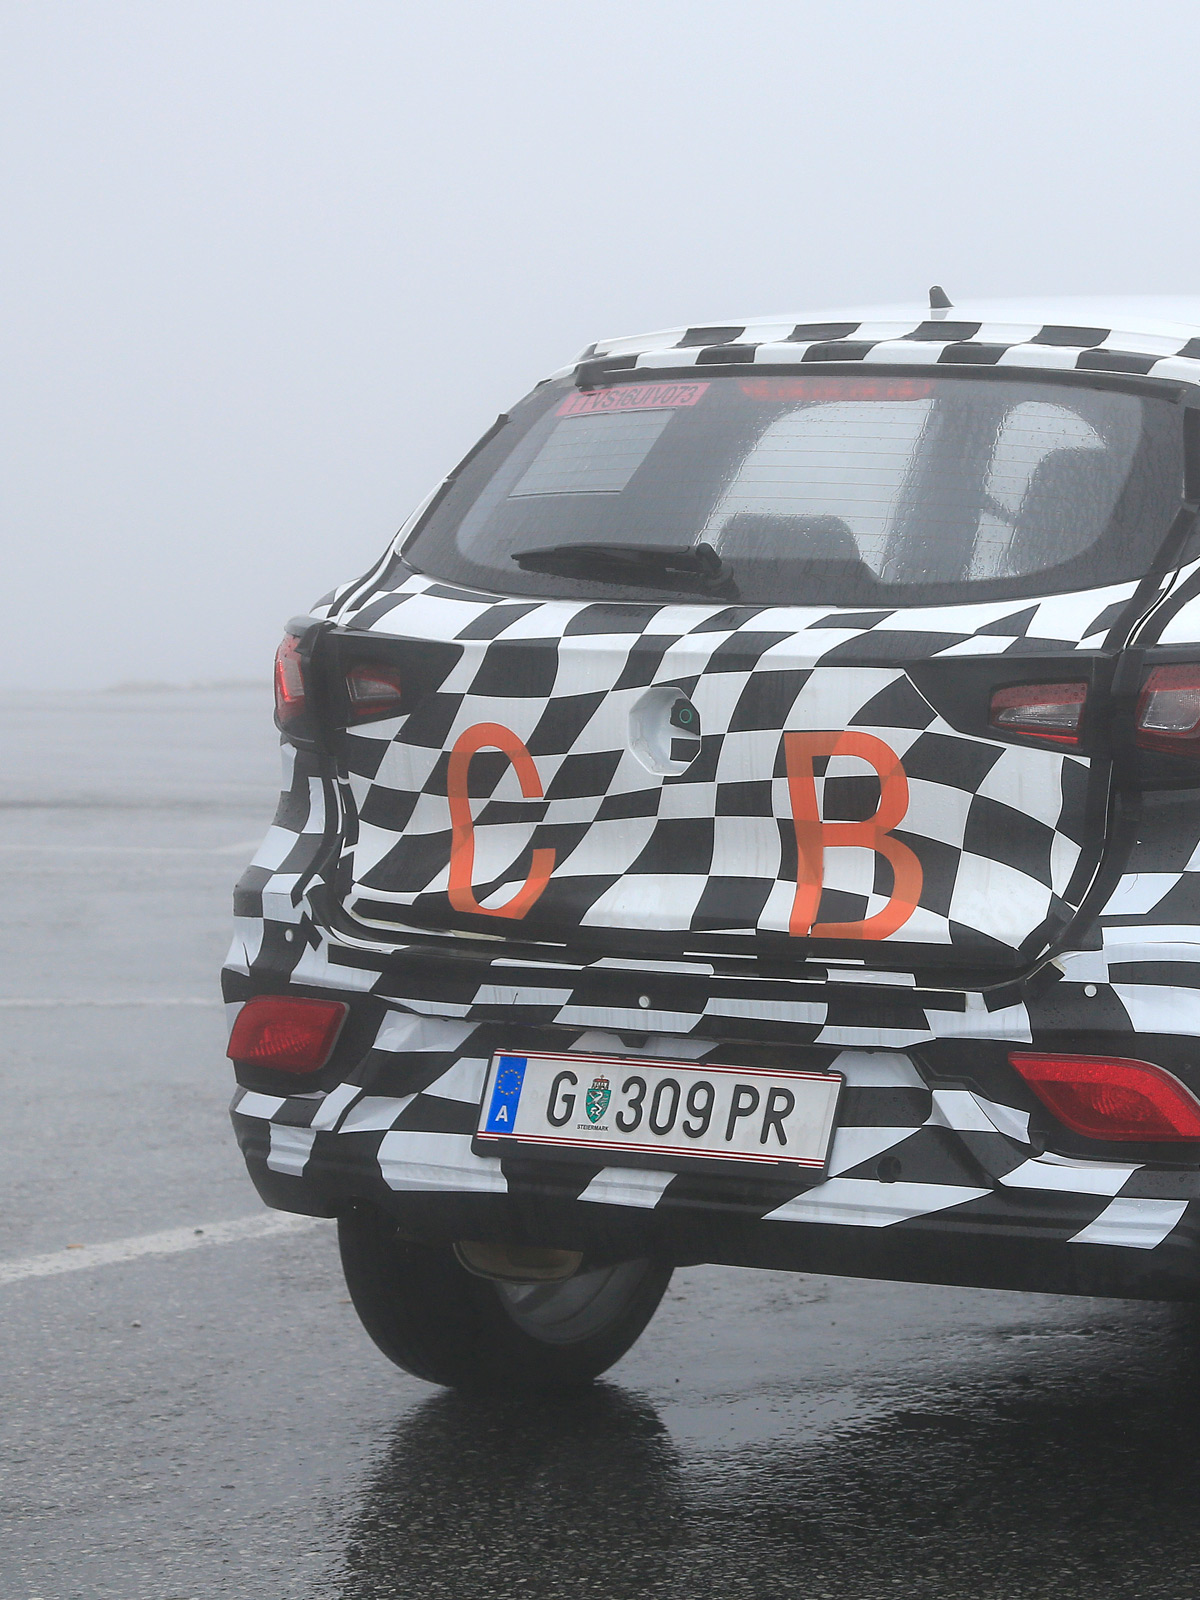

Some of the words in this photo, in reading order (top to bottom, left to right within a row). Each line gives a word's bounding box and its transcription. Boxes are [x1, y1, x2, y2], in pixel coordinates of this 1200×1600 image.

[446, 722, 556, 920] C
[783, 730, 924, 941] B
[494, 1105, 509, 1123] A
[546, 1070, 578, 1128] G
[615, 1075, 716, 1139] 309
[725, 1084, 796, 1146] PR
[576, 1123, 610, 1132] STEIERMARK
